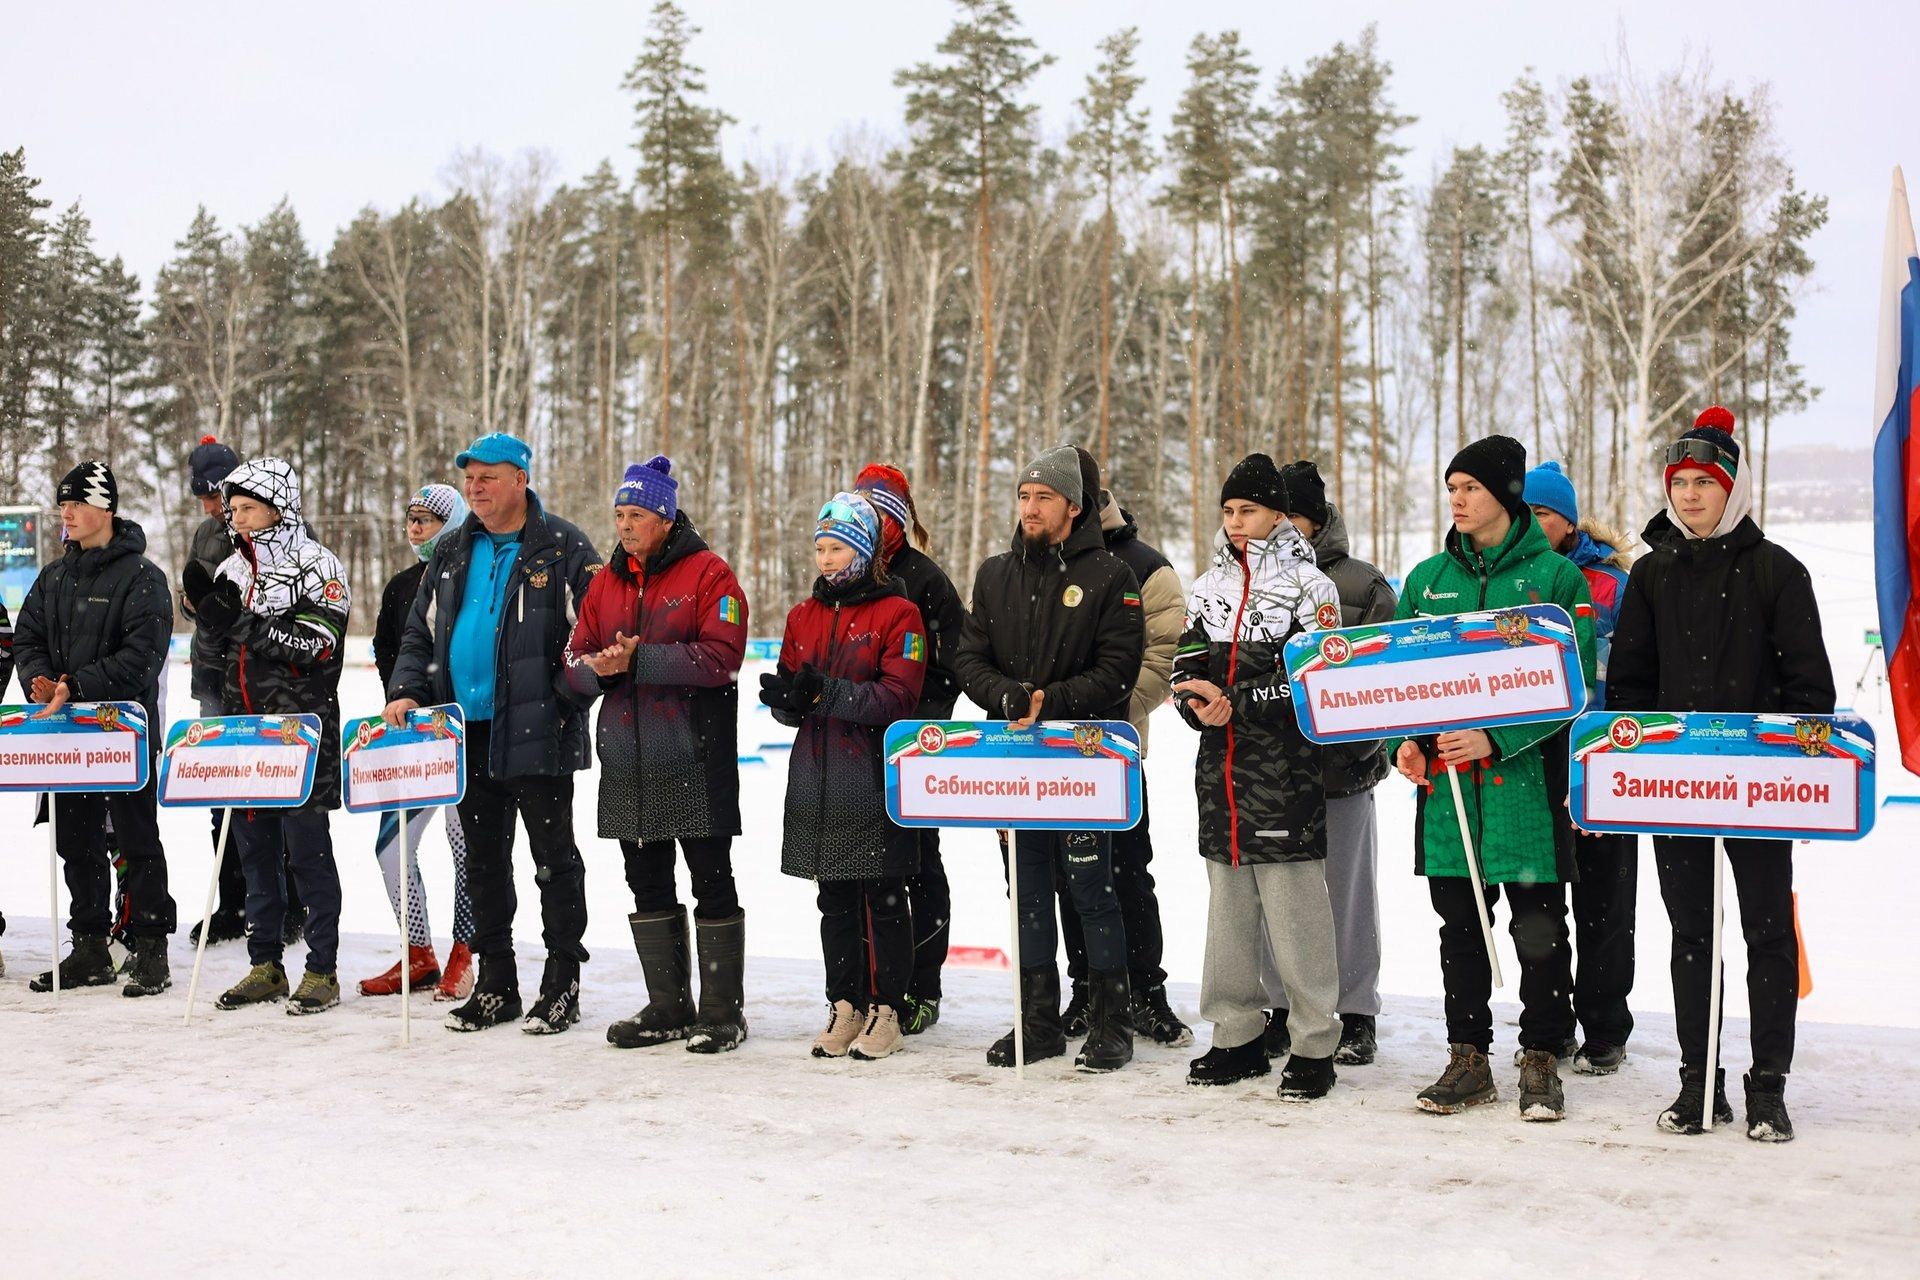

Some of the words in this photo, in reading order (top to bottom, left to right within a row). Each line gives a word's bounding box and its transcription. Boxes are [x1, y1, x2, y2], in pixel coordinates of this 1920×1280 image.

[1320, 672, 1482, 710] Альметьевский
[1488, 666, 1555, 697] район
[0, 747, 81, 766] зелинский
[86, 746, 131, 768] район
[352, 759, 422, 785] Нижнекамский
[425, 757, 455, 781] район
[177, 761, 252, 782] Набережные
[256, 761, 298, 778] Челны
[924, 774, 1030, 797] Сабинский
[1036, 776, 1096, 801] район
[1612, 771, 1738, 801] Заинский
[1747, 776, 1830, 807] район
[548, 977, 579, 1023] alpina
